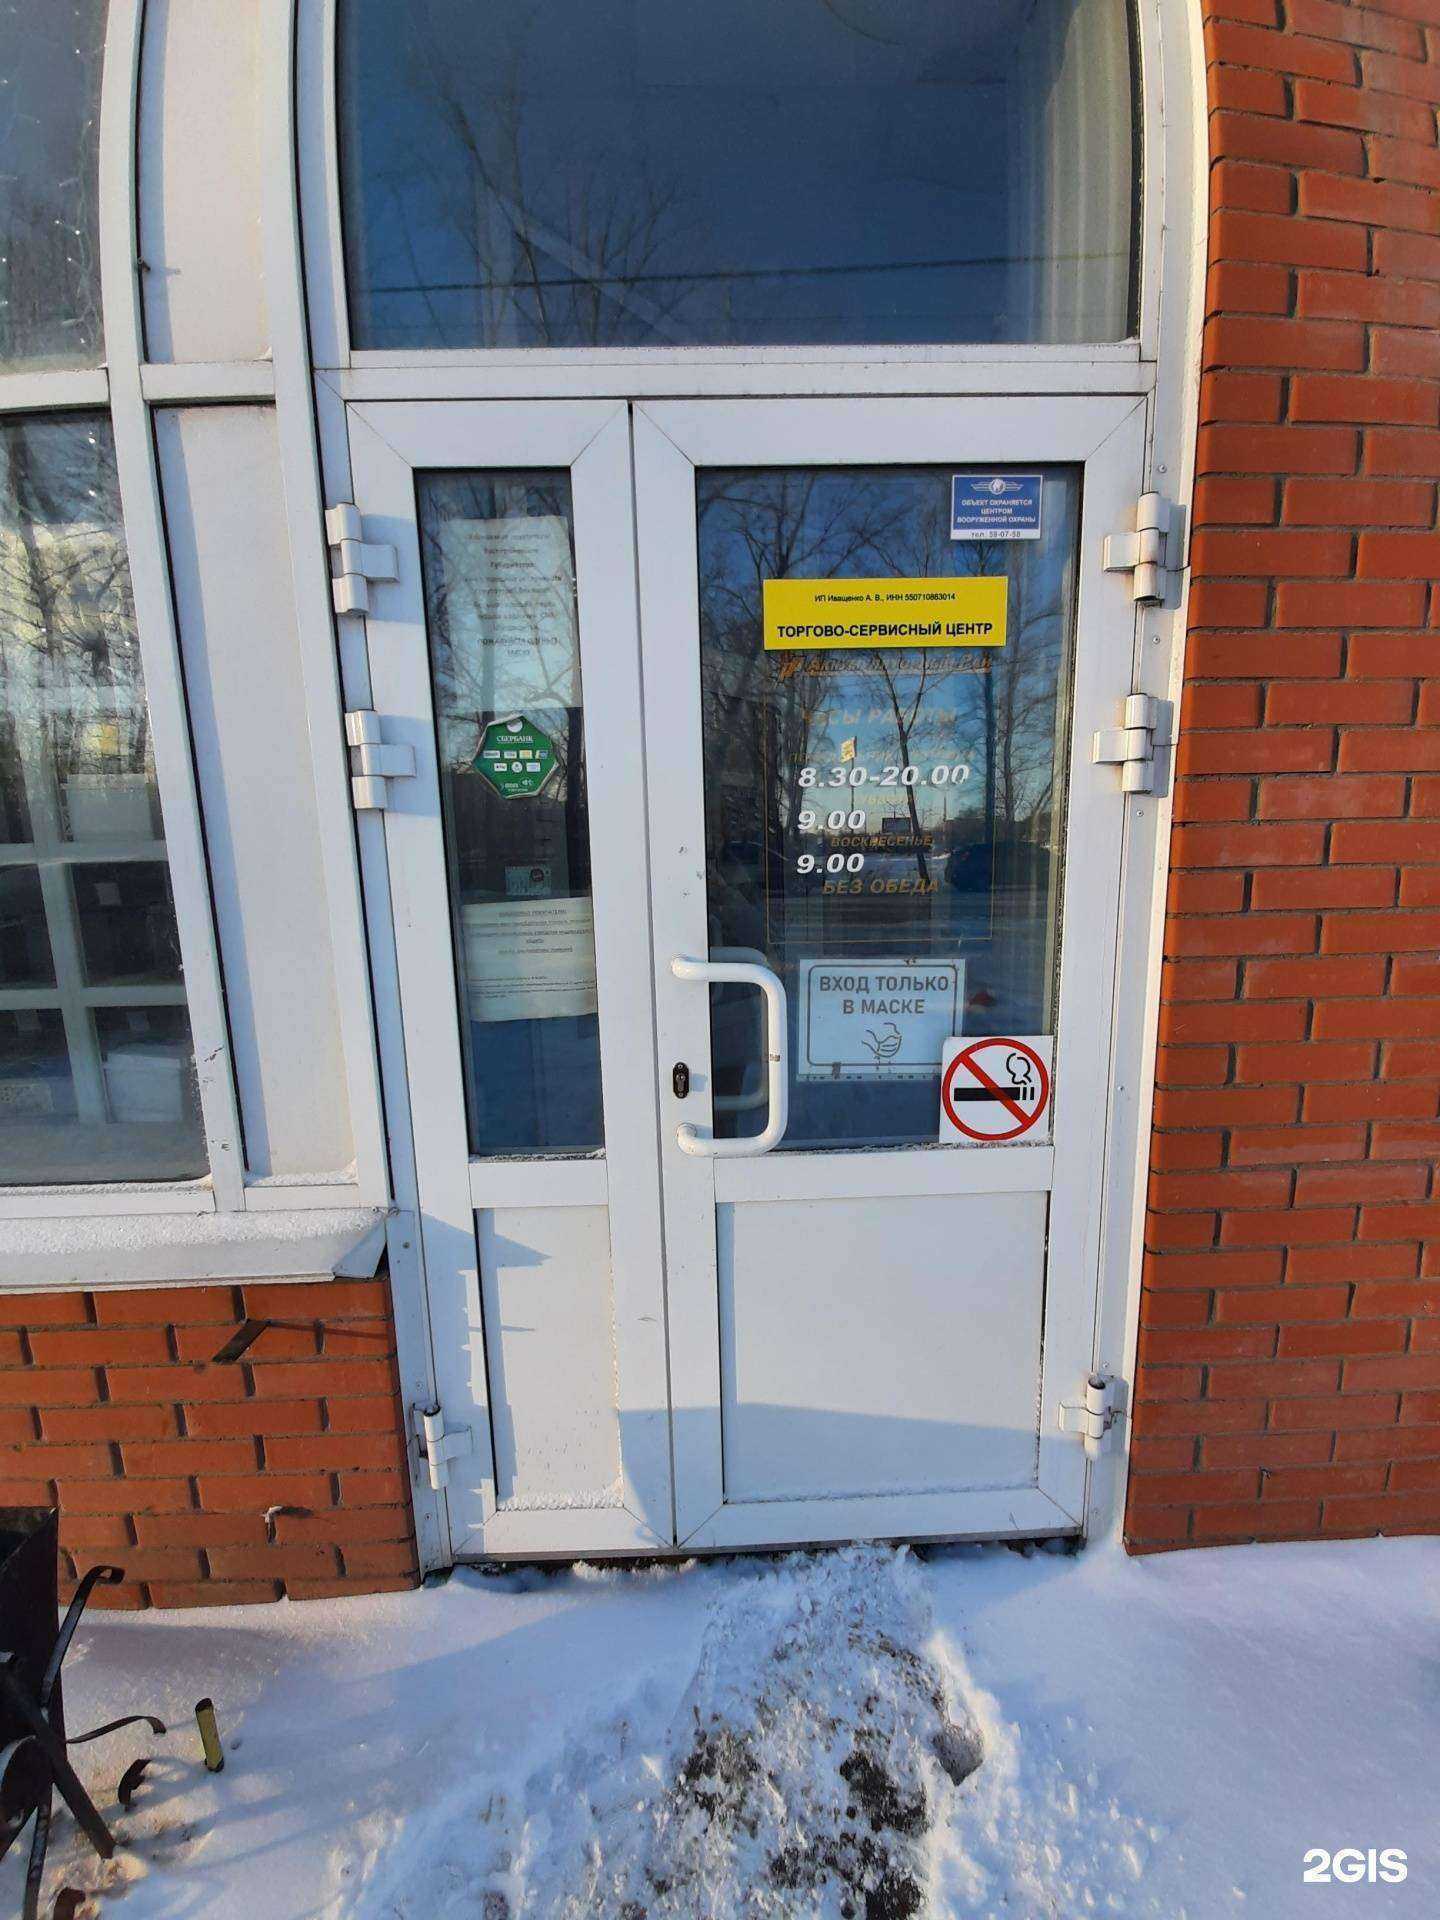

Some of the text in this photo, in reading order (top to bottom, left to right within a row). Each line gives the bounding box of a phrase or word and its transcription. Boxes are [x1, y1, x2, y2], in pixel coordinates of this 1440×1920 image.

[814, 594, 826, 602] ИП
[886, 593, 904, 601] ИНН
[777, 621, 993, 638] ТОРГОВО-СЕРВИСНЫЙ ЦЕНТР
[798, 764, 970, 787] 8.30-20.00
[797, 810, 866, 830] 9.00
[796, 853, 865, 874] 9.00
[822, 878, 940, 896] БЕЗ ОБЕДА
[819, 976, 949, 994] ВХОД ТОЛЬКО
[843, 999, 926, 1014] В МАСКЕ
